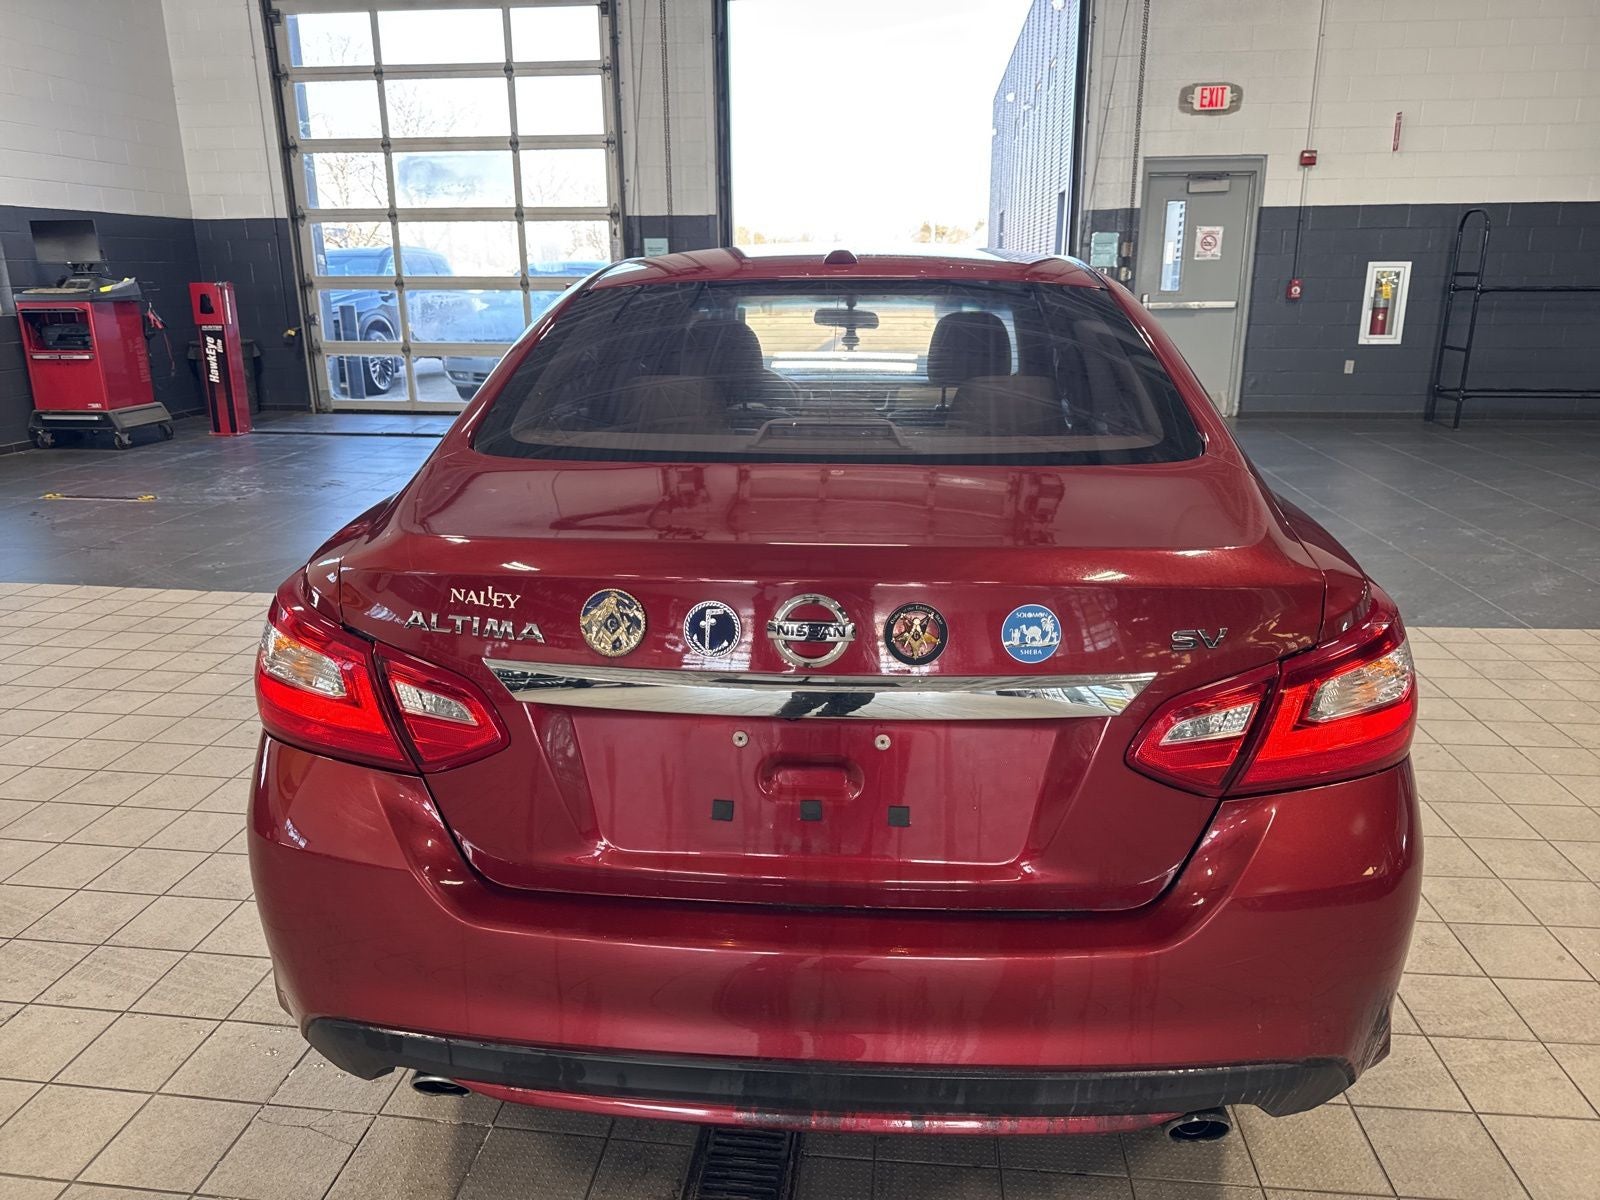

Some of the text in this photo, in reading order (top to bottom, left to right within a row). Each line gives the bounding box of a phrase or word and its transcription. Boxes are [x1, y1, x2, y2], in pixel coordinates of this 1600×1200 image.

[1200, 87, 1227, 108] EXIT
[450, 586, 521, 609] NALLEY
[404, 610, 545, 643] ALTIMA
[776, 622, 846, 638] NISSAN
[1172, 628, 1228, 650] SV
